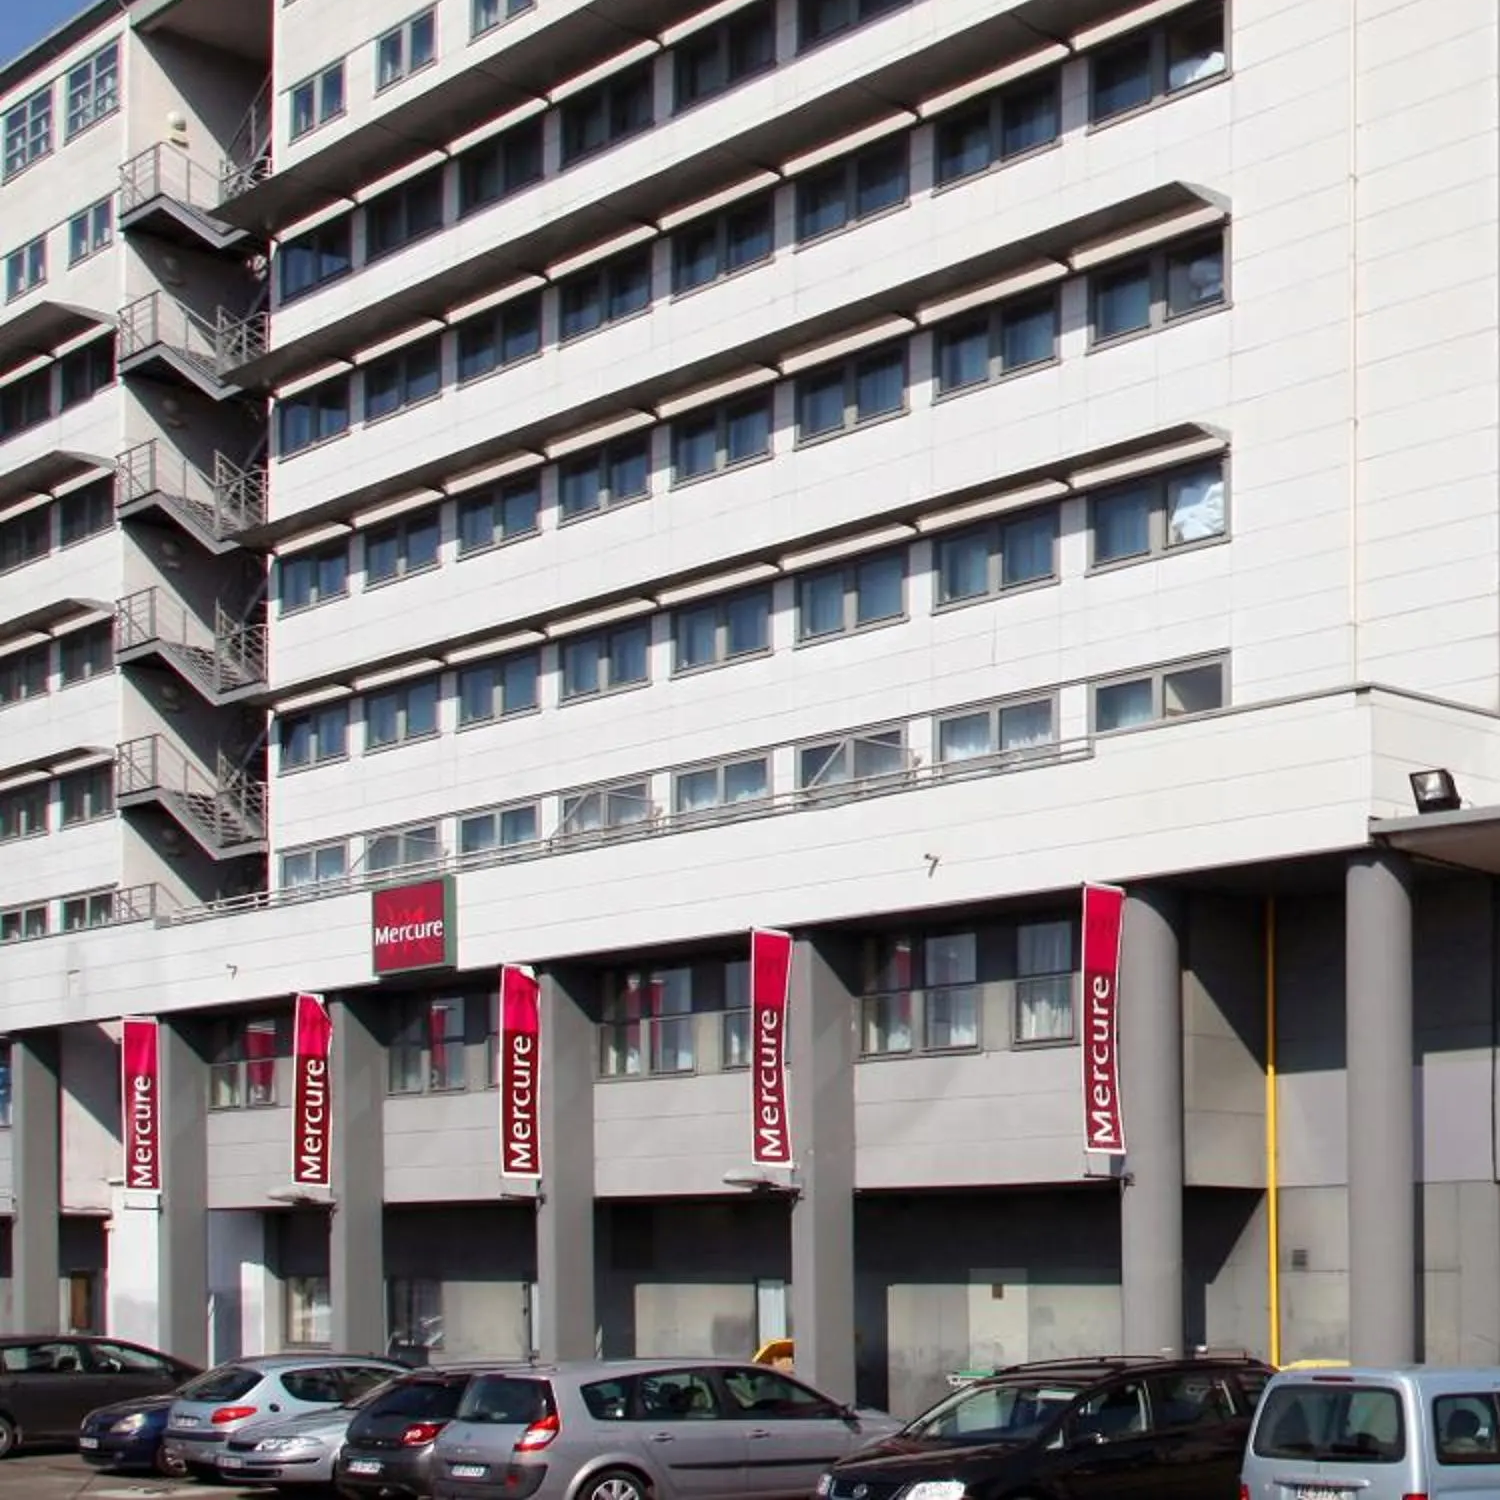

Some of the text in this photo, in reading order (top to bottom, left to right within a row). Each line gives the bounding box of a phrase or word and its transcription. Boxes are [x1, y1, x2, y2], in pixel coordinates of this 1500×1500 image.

[375, 919, 443, 946] Mercure
[301, 1058, 325, 1179] Mercure
[509, 1034, 533, 1169] Mercure
[759, 1009, 783, 1157] Mercure
[1091, 976, 1116, 1143] Mercure
[132, 1075, 153, 1187] Mercure
